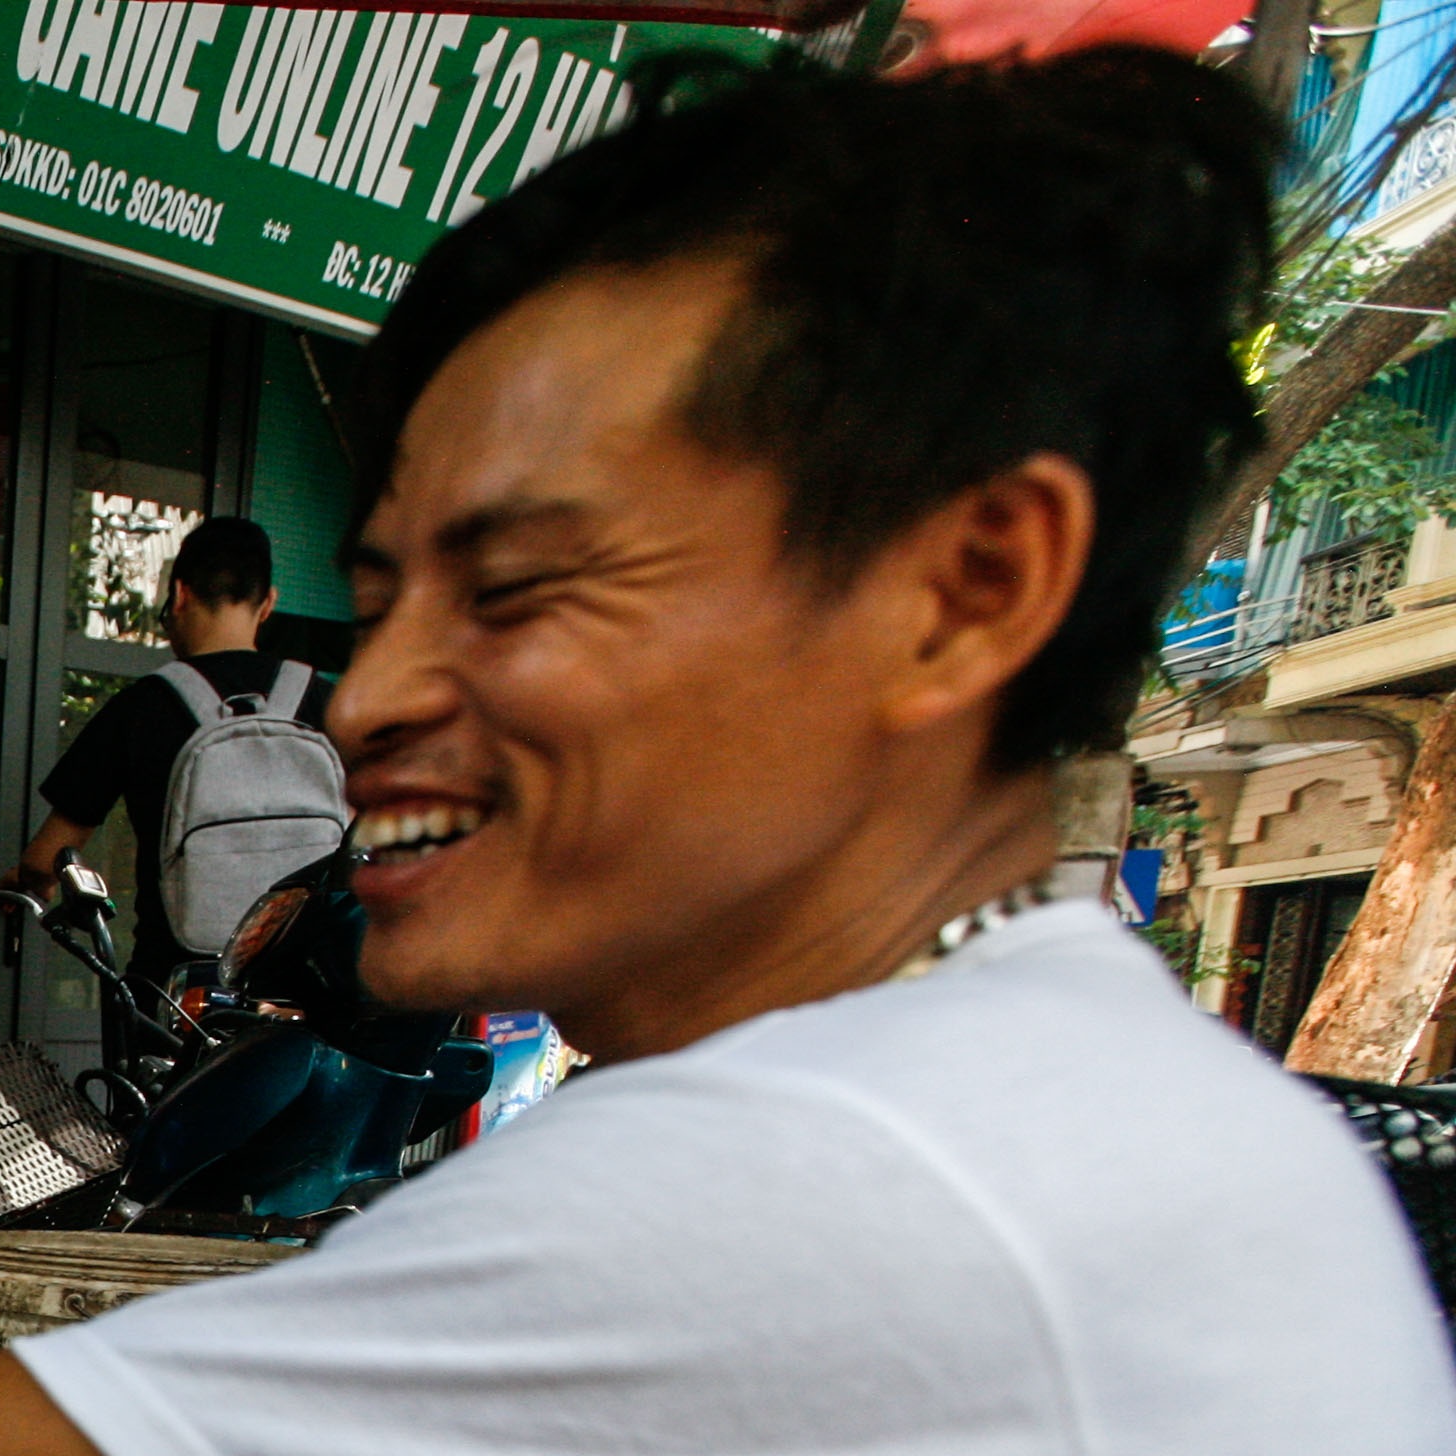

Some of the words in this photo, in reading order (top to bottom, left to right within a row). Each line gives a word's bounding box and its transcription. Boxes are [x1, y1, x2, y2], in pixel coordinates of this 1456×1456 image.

[425, 26, 541, 229] 12
[77, 160, 129, 217] 01C
[124, 176, 225, 247] 8020601
[358, 253, 394, 299] 12
